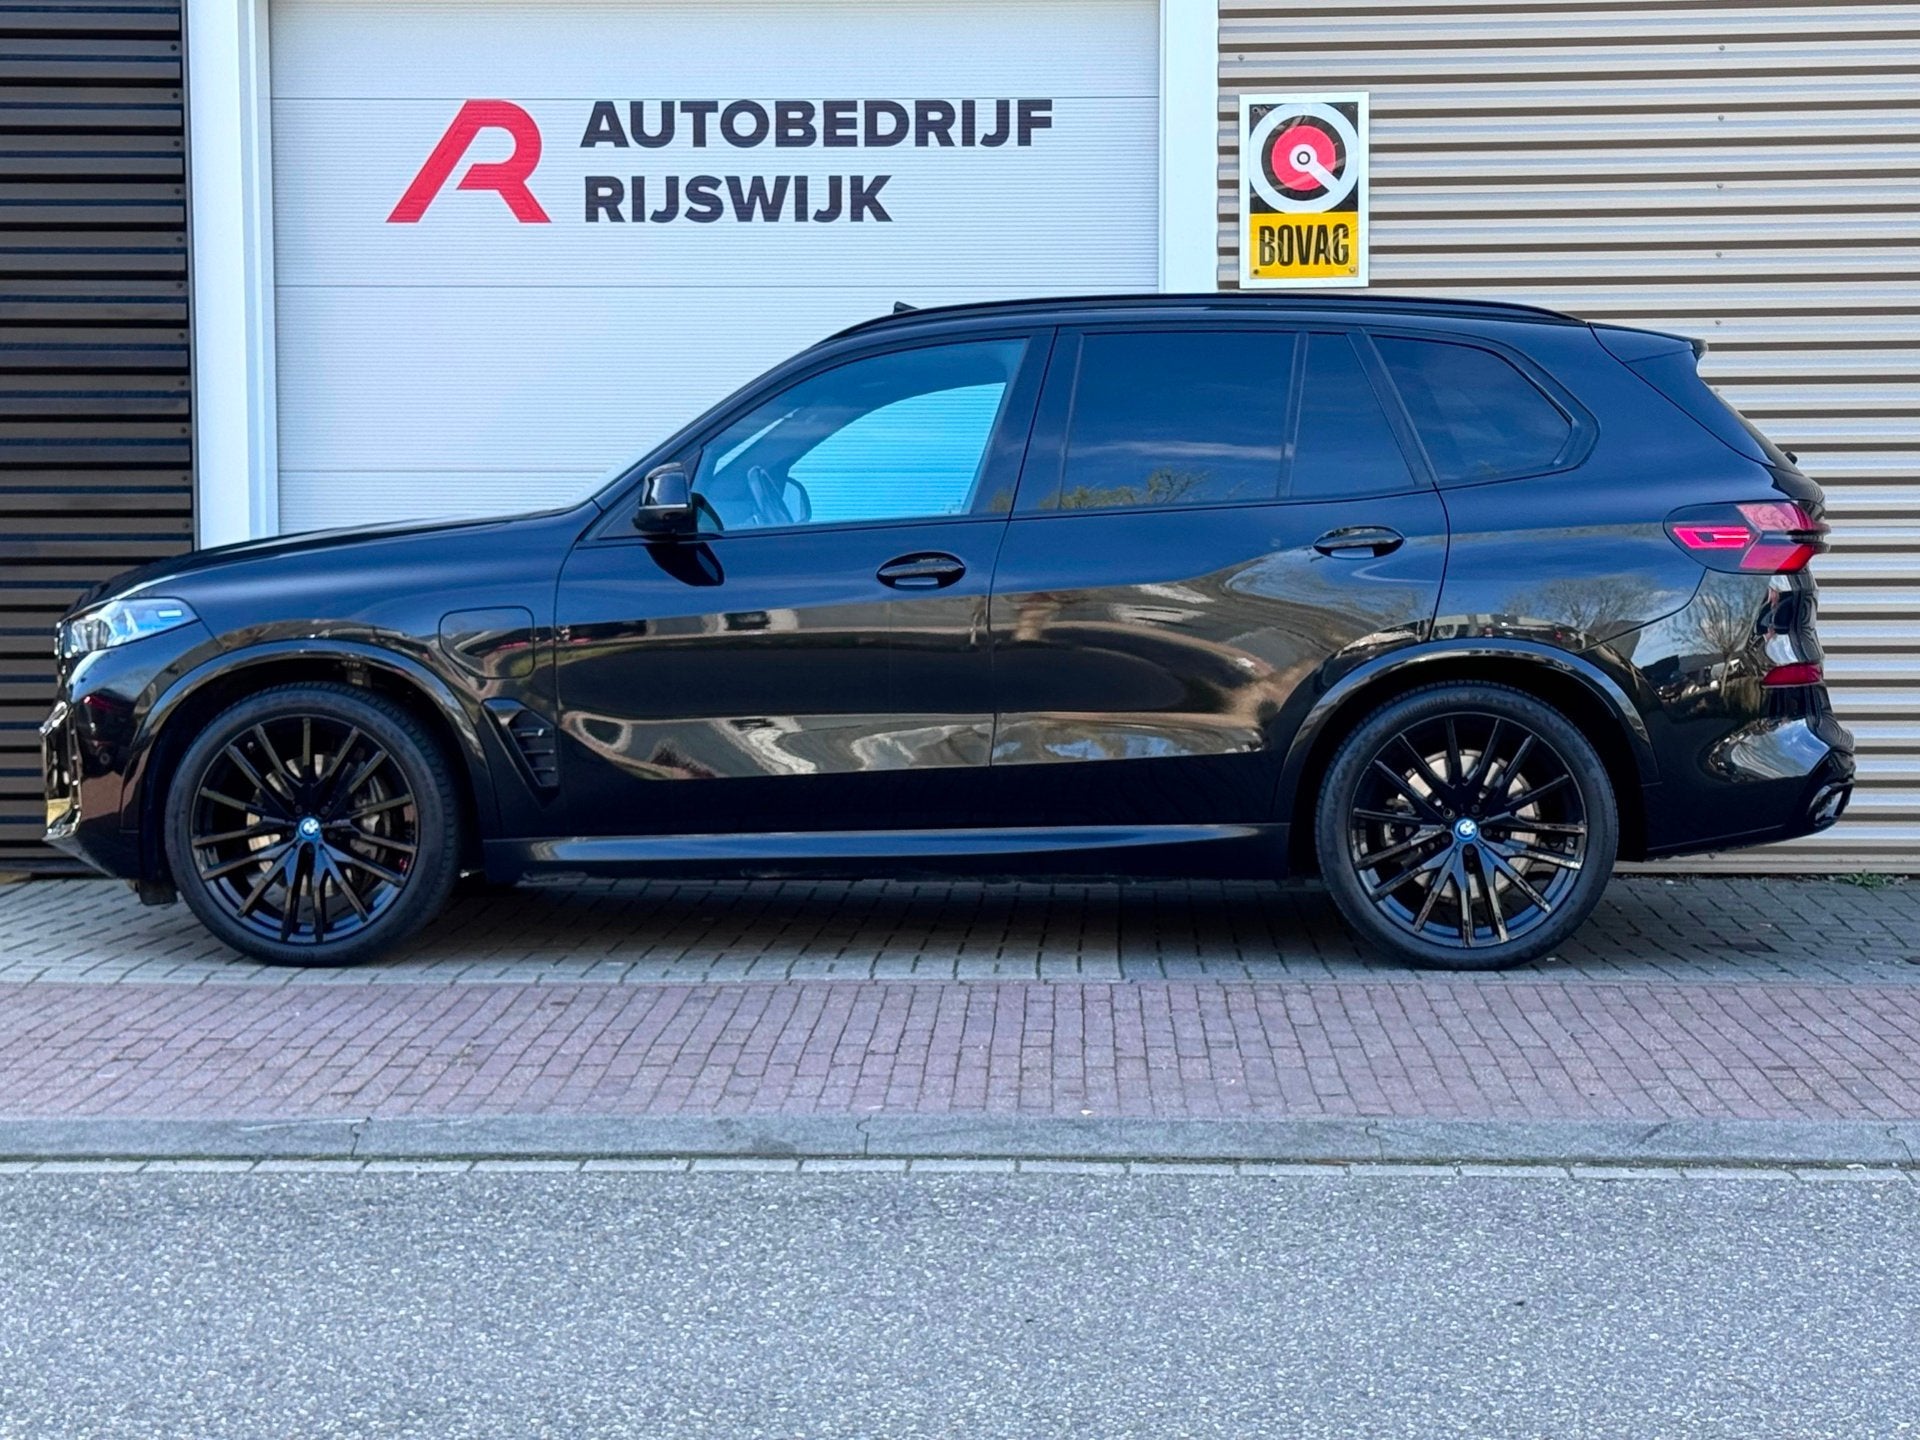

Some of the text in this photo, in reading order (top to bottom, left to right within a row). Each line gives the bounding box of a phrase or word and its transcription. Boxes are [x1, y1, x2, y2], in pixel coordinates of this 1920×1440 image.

[580, 100, 1053, 149] AUTOBEDRIJF
[584, 175, 893, 223] RIJSWIJK
[1258, 223, 1350, 267] BOVAG
